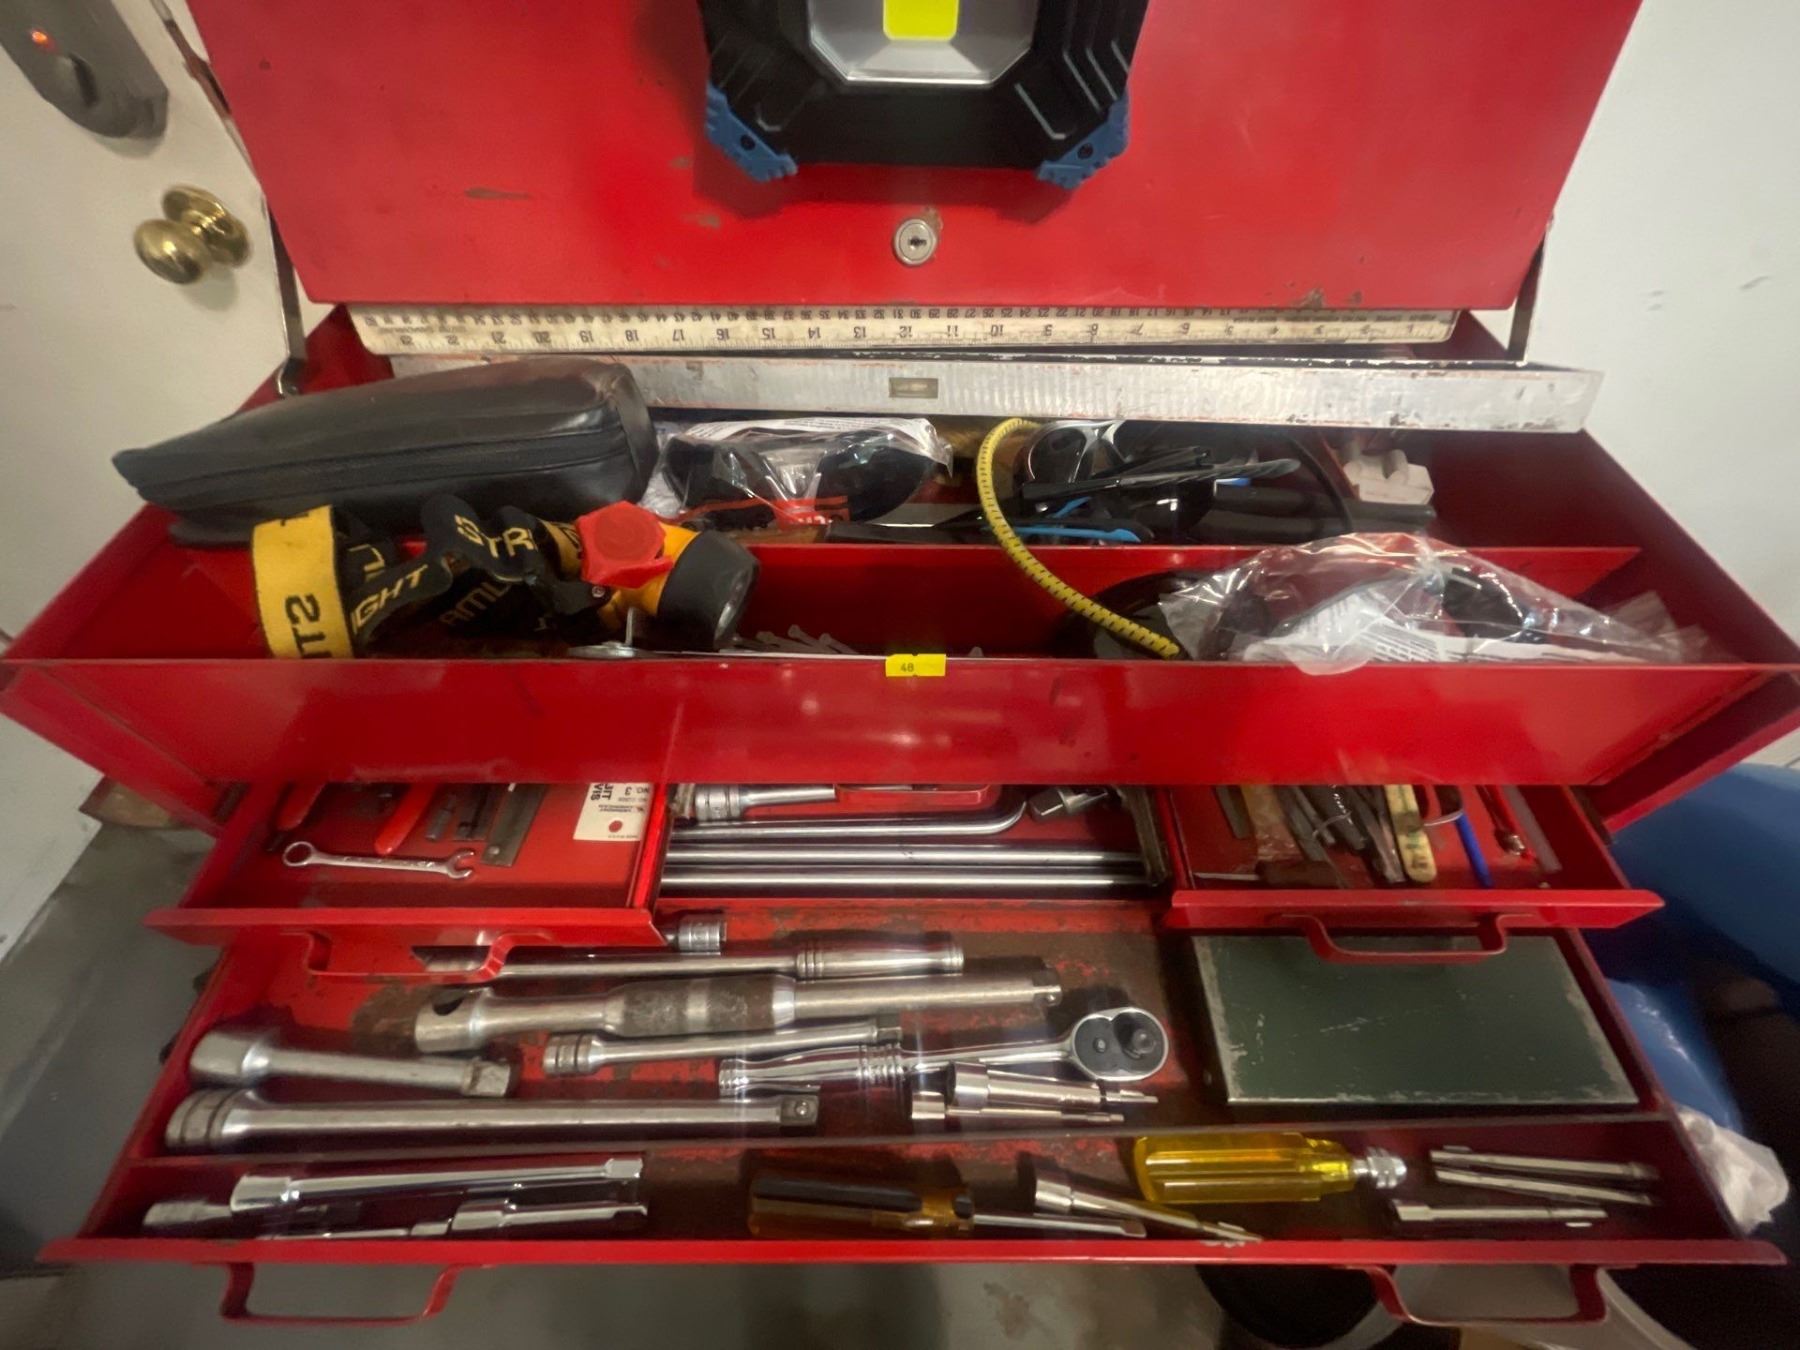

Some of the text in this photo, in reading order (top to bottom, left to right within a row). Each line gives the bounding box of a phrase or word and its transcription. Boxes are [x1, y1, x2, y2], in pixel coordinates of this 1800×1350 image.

[710, 311, 721, 322] 41
[801, 310, 812, 320] 36
[819, 310, 831, 320] 35
[837, 310, 849, 320] 34
[855, 309, 866, 320] 33
[873, 309, 885, 319] 32
[893, 308, 904, 319] 31
[910, 308, 922, 319] 30
[929, 308, 940, 319] 29
[947, 308, 959, 319] 28
[965, 308, 976, 318] 27
[983, 308, 994, 318] 26
[1001, 308, 1013, 318] 25
[1019, 308, 1031, 317] 24
[1038, 308, 1050, 317] 23
[1056, 307, 1067, 317] 22
[625, 329, 640, 342] 18
[672, 329, 685, 342] 17
[716, 328, 730, 341] 16
[762, 327, 776, 340] 15
[808, 327, 821, 339] 14
[853, 326, 867, 339] 13
[899, 325, 912, 338] 12
[946, 325, 959, 337] 11
[990, 324, 1004, 337] 10
[532, 331, 551, 344] 20
[579, 330, 594, 343] 19
